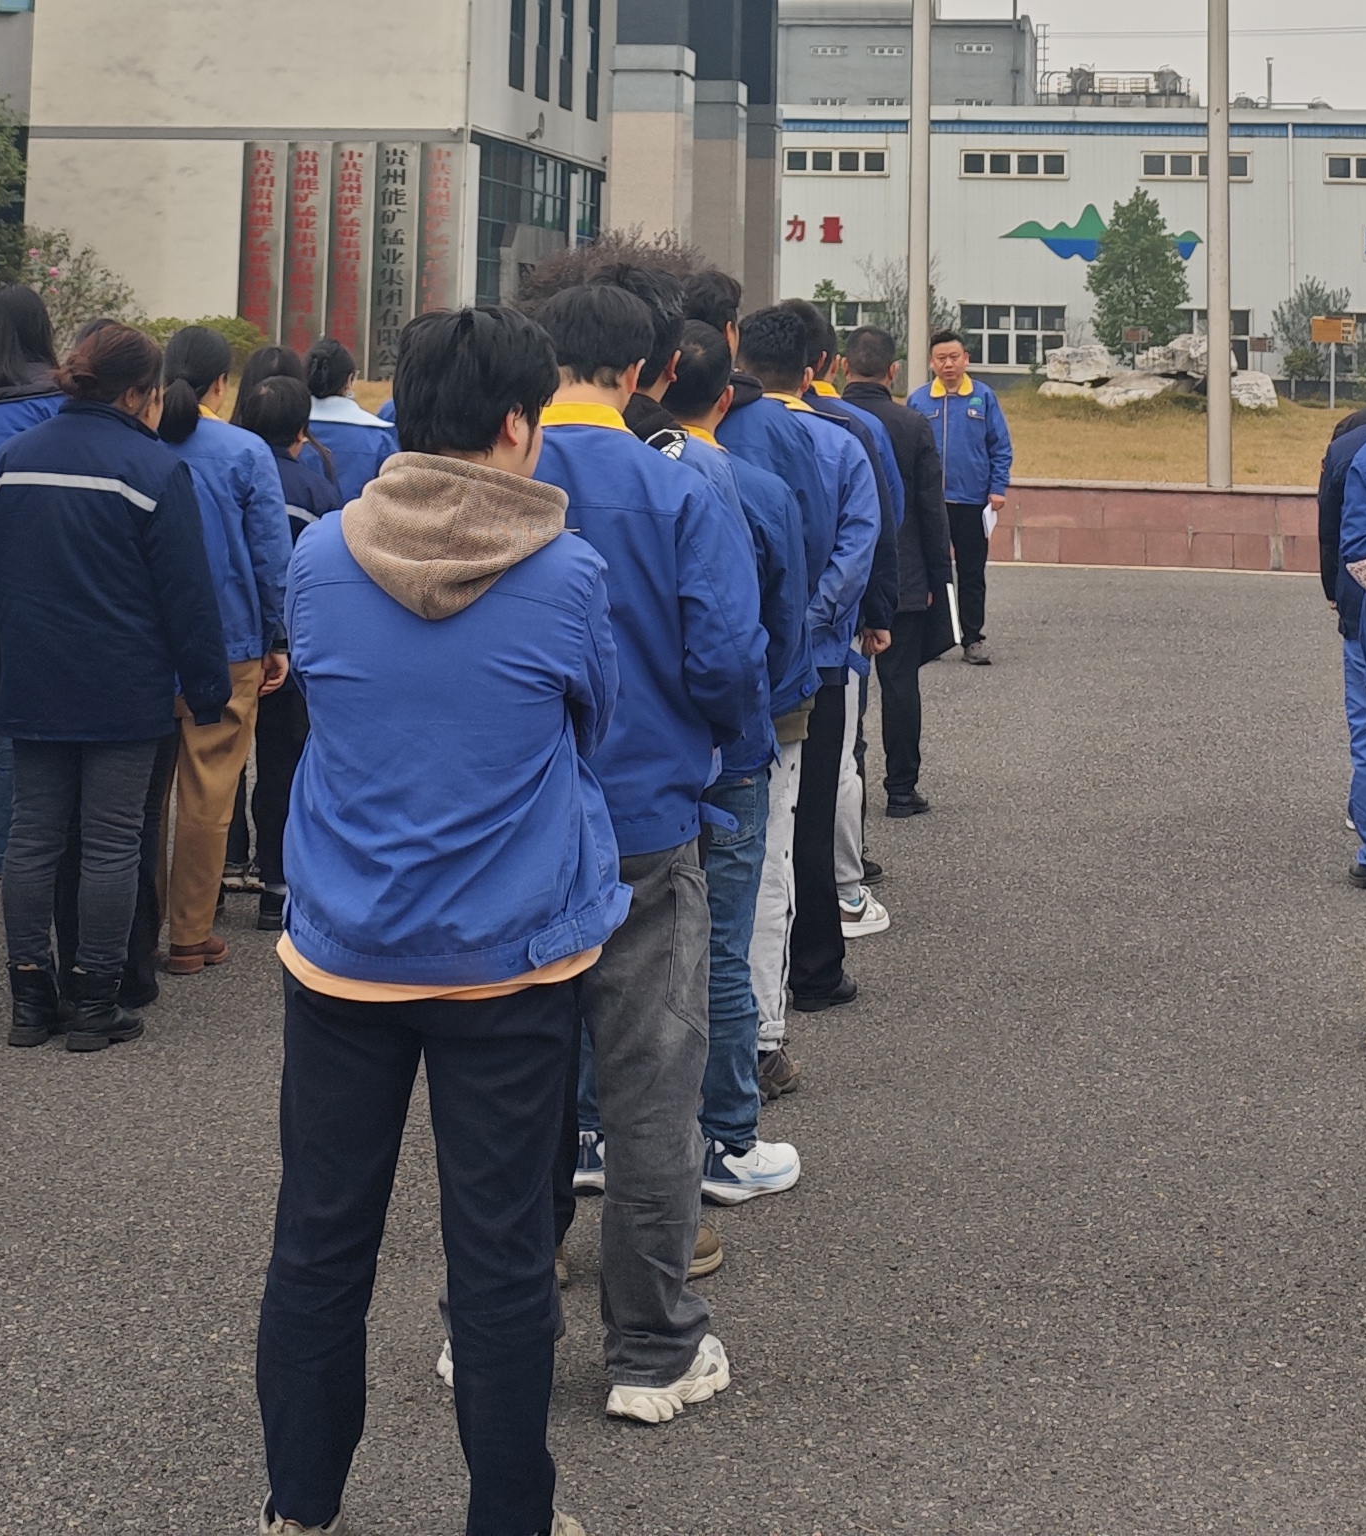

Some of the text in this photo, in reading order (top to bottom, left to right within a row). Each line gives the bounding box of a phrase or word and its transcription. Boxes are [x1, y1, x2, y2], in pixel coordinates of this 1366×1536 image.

[377, 148, 409, 380] 贵州能矿锰业集团有限公
[785, 214, 844, 244] 力量
